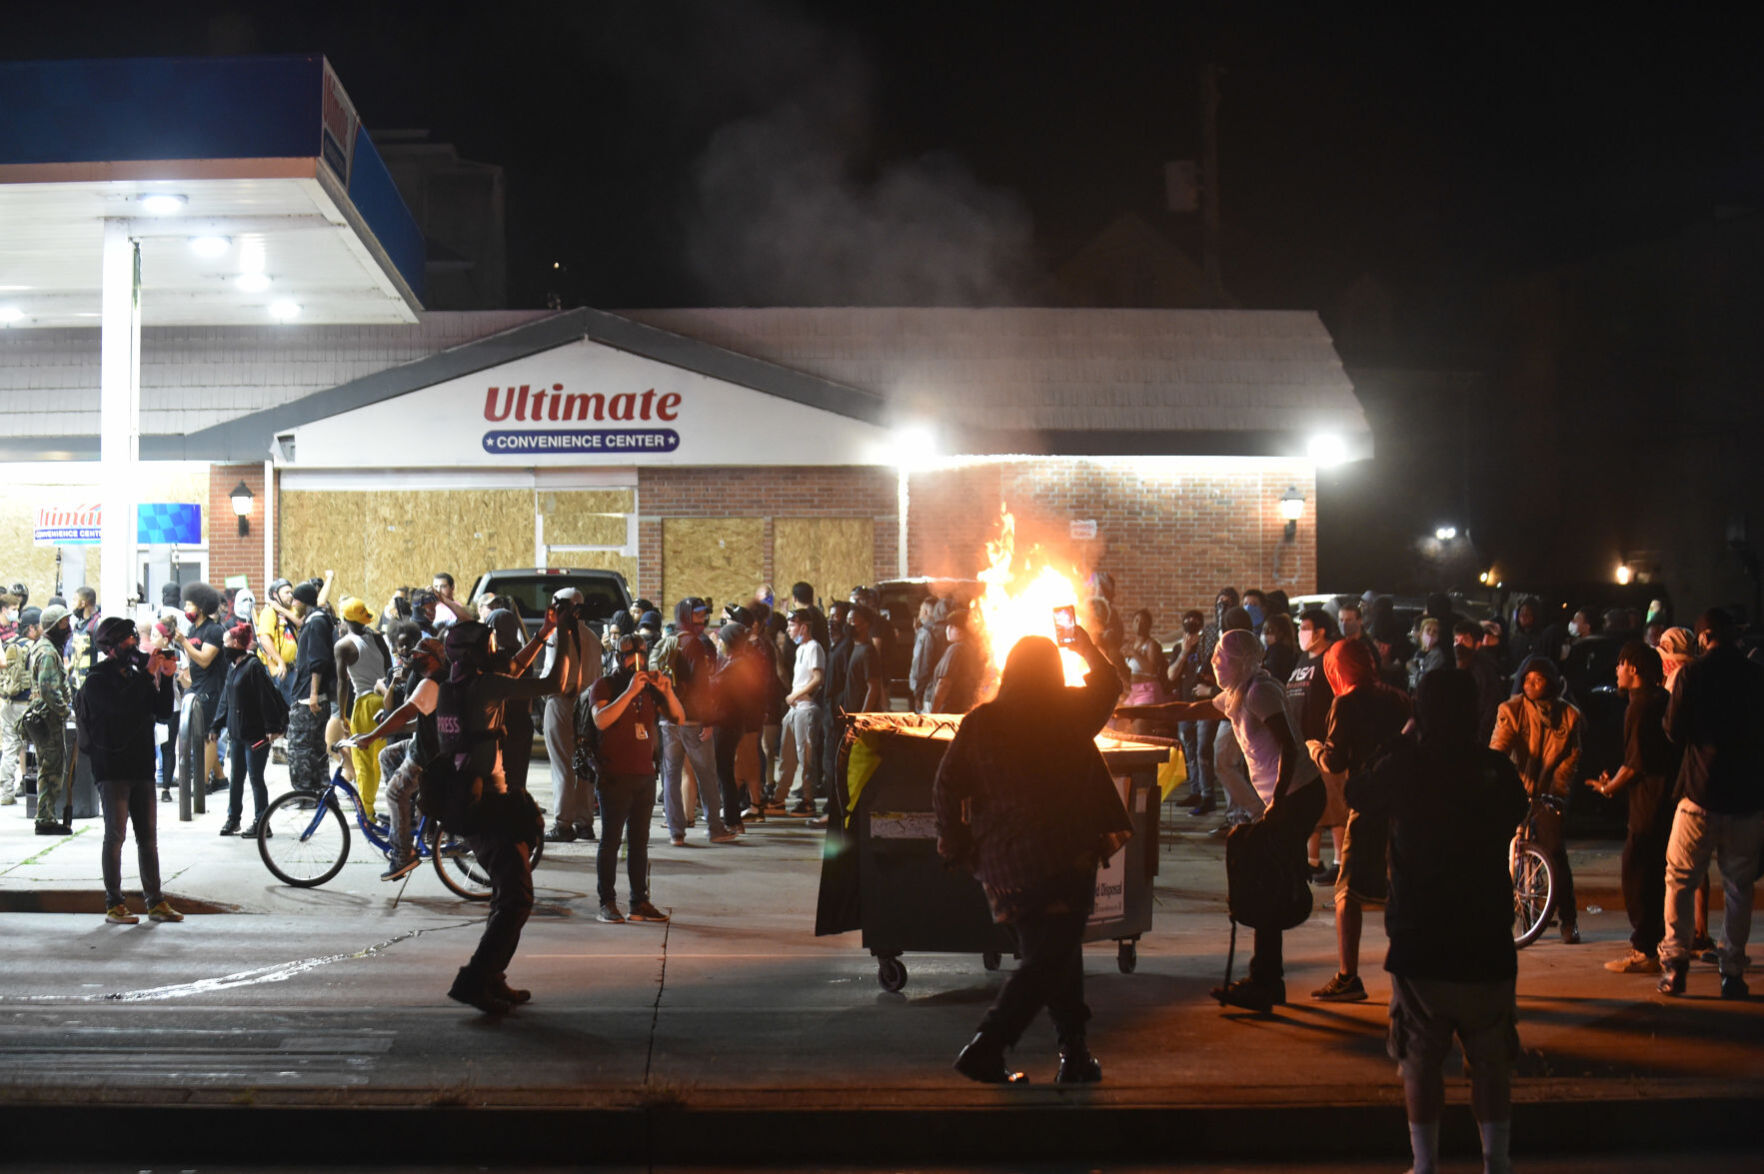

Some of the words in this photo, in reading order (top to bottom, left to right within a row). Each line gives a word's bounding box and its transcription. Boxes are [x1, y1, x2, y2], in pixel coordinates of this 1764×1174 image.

[484, 384, 682, 422] Ultimate
[497, 435, 601, 449] CONVENIENCE
[605, 434, 665, 448] CENTER
[79, 529, 101, 538] CENT
